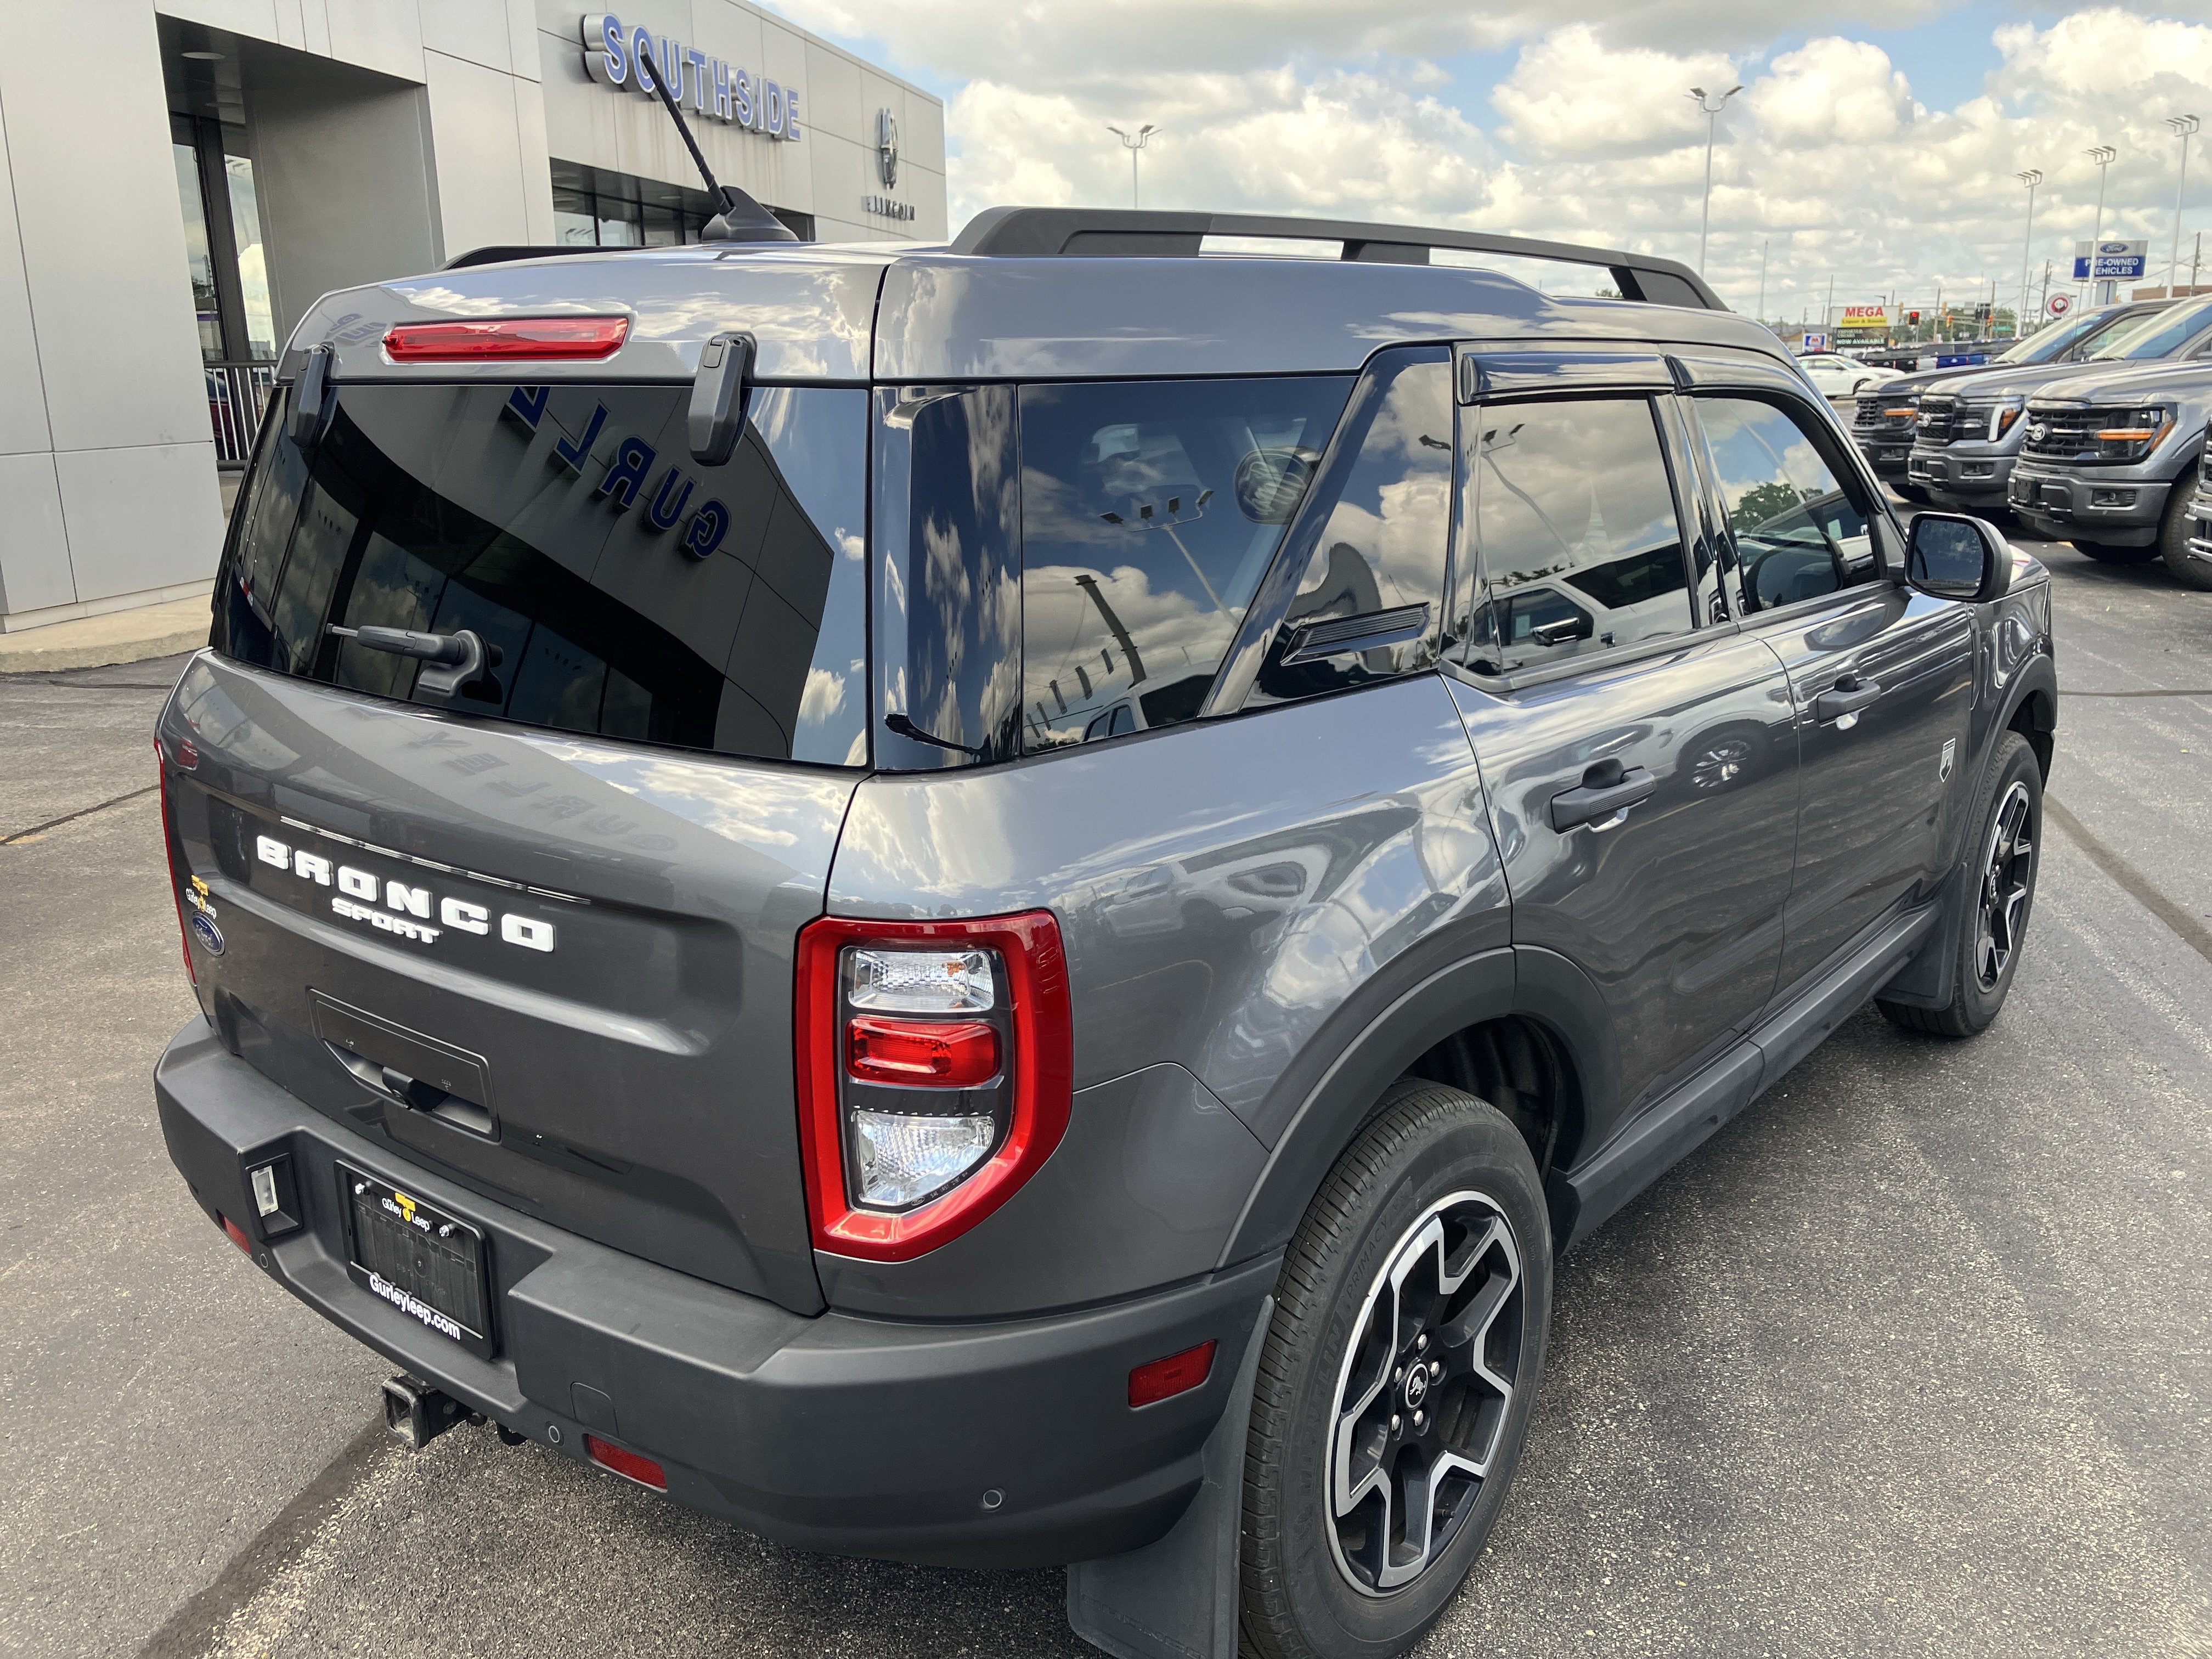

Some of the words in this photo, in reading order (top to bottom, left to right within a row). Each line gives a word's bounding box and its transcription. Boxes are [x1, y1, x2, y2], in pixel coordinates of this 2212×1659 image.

[601, 13, 802, 141] SOUTHSIDE
[2085, 258, 2138, 267] PE-OWNED
[2095, 266, 2133, 275] EHICLES
[1844, 306, 1884, 317] MEGA
[257, 834, 556, 953] BRONCO
[331, 898, 442, 944] SPORT
[411, 1211, 430, 1232] Leep
[1346, 1216, 1390, 1300] PRIMACY
[370, 1274, 461, 1340] Gurleyleep.com
